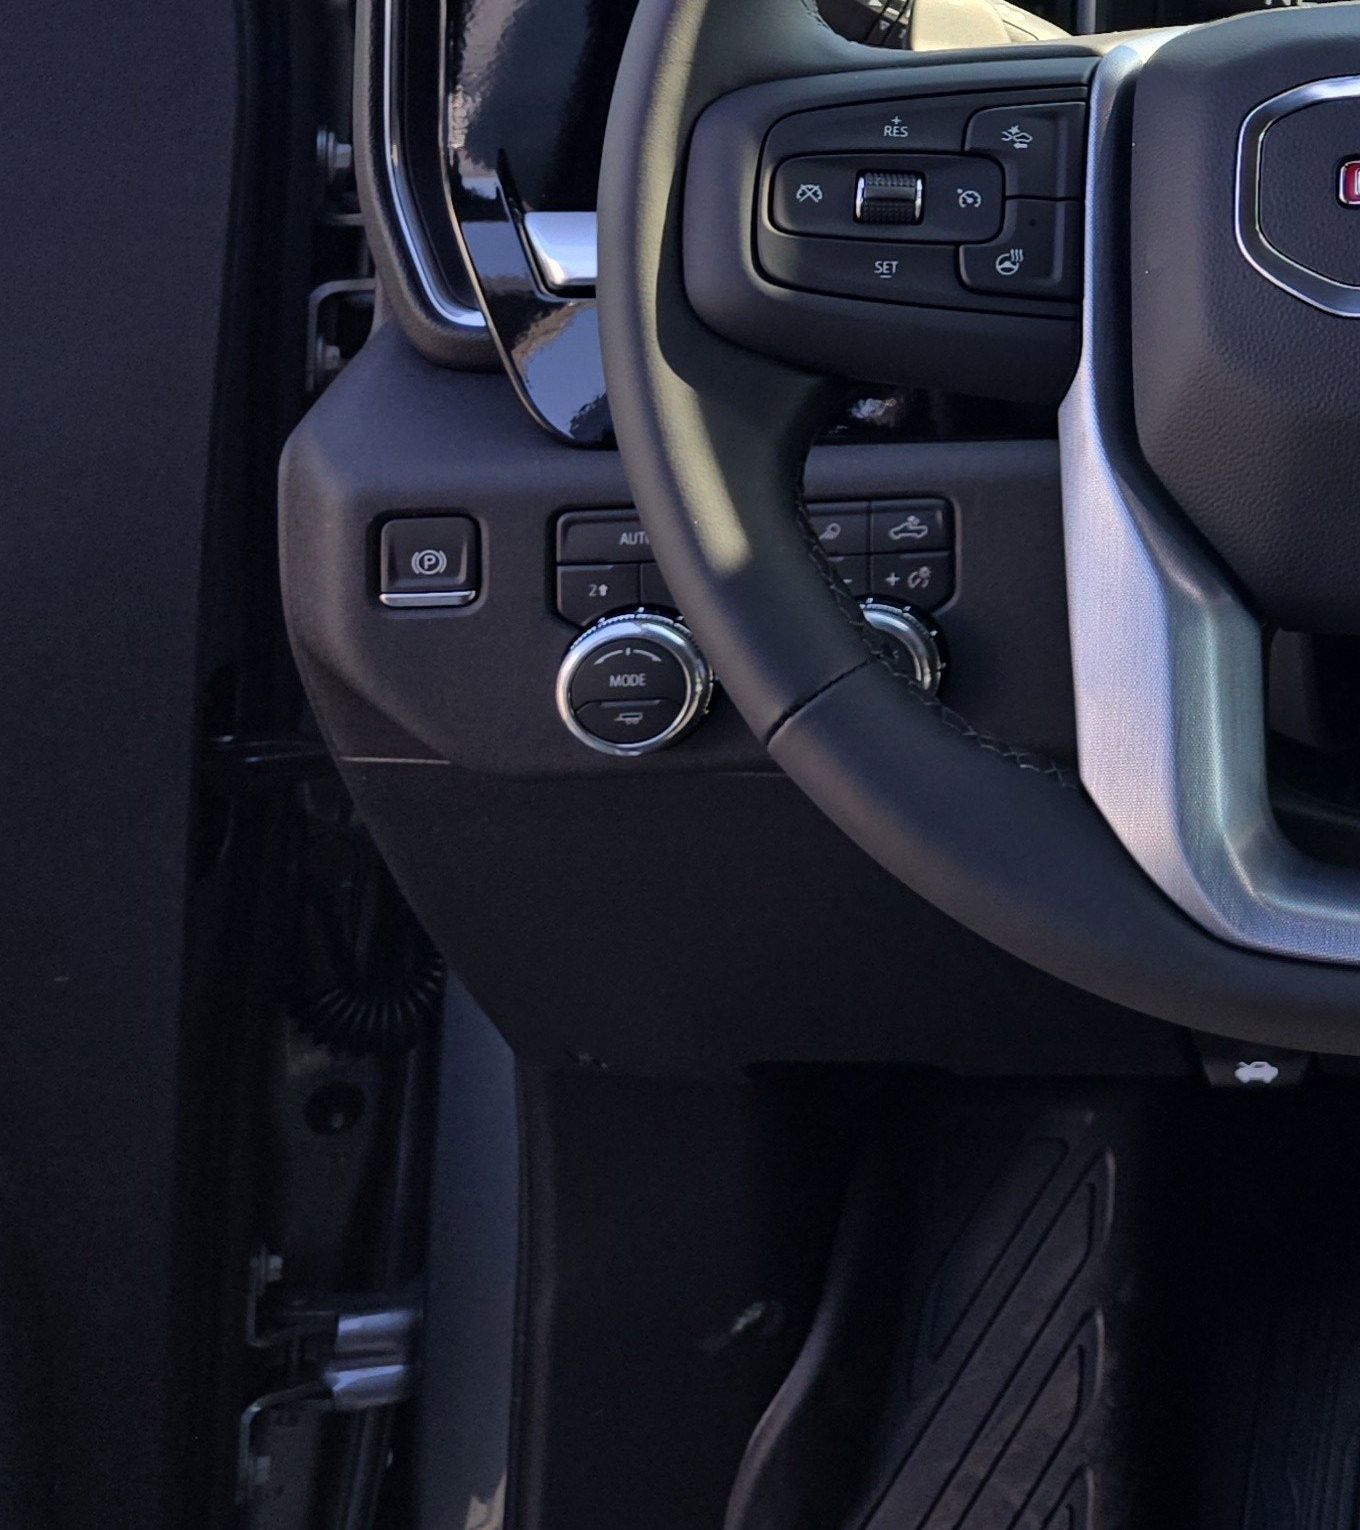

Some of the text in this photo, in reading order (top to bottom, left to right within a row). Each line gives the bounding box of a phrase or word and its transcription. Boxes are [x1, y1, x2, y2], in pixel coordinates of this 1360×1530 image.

[884, 125, 909, 138] RES
[874, 260, 899, 274] SET
[619, 531, 650, 546] AUT
[609, 673, 647, 687] MODE
